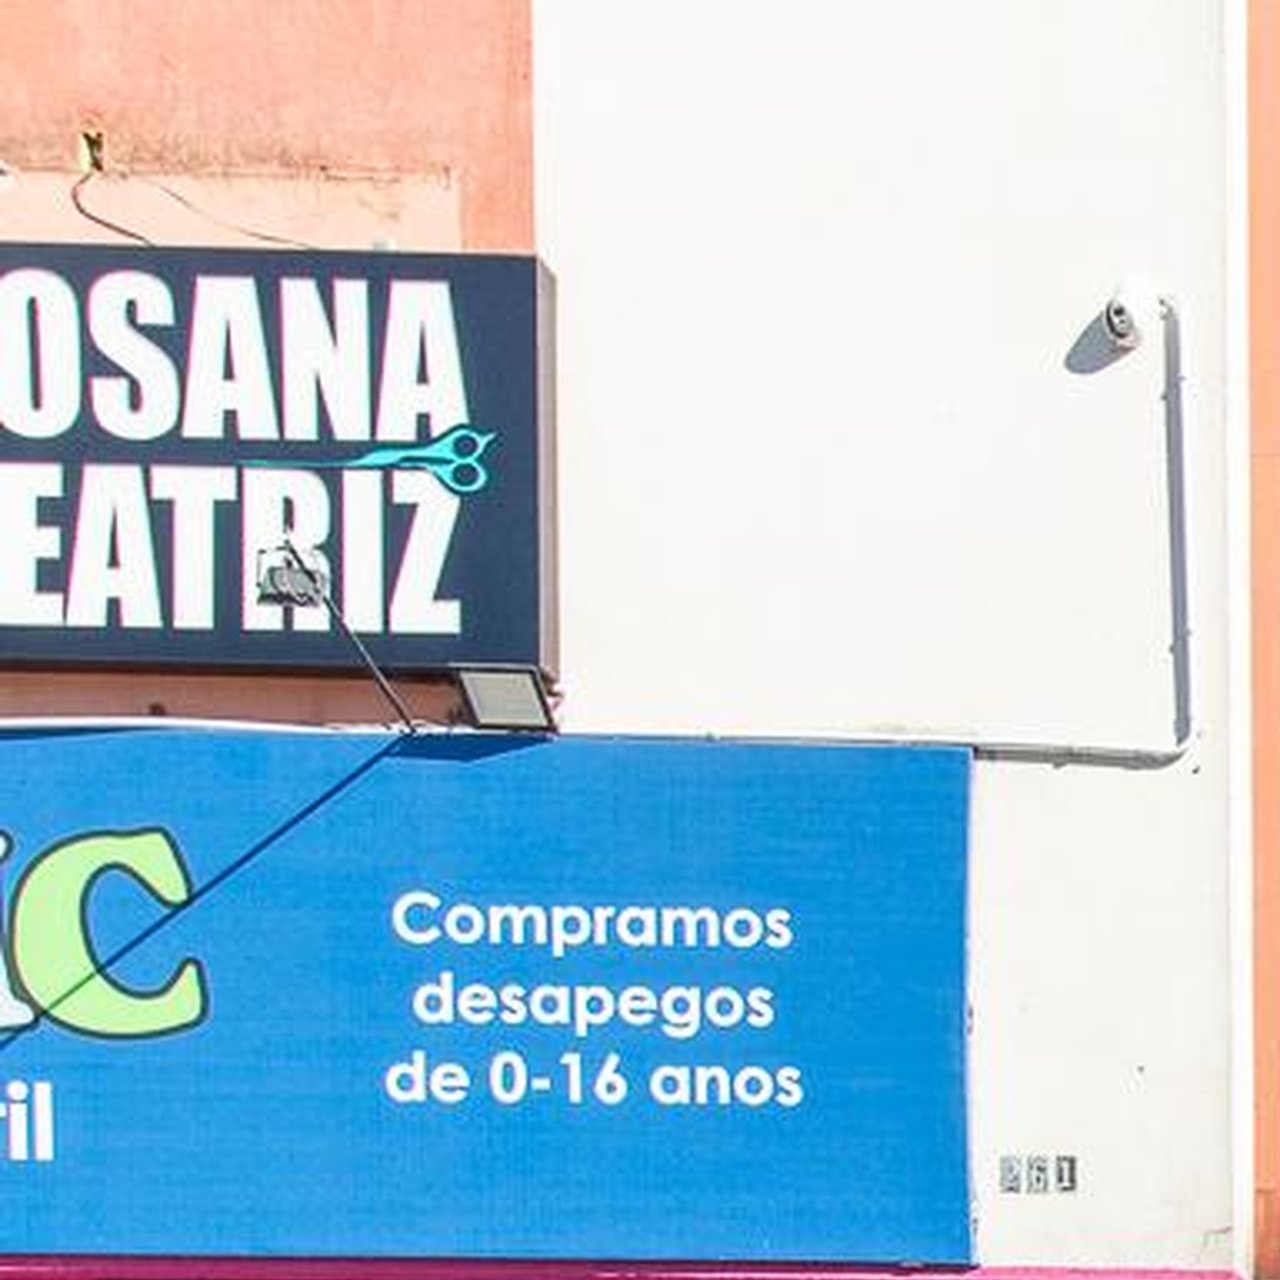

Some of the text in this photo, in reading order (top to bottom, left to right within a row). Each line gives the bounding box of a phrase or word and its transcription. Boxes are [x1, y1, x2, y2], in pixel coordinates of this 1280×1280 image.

[0, 270, 470, 441] OSANA
[391, 891, 794, 958] Compramos
[412, 971, 775, 1038] desapegos
[384, 1050, 804, 1106] de 0-16 anos
[0, 1079, 54, 1162] il
